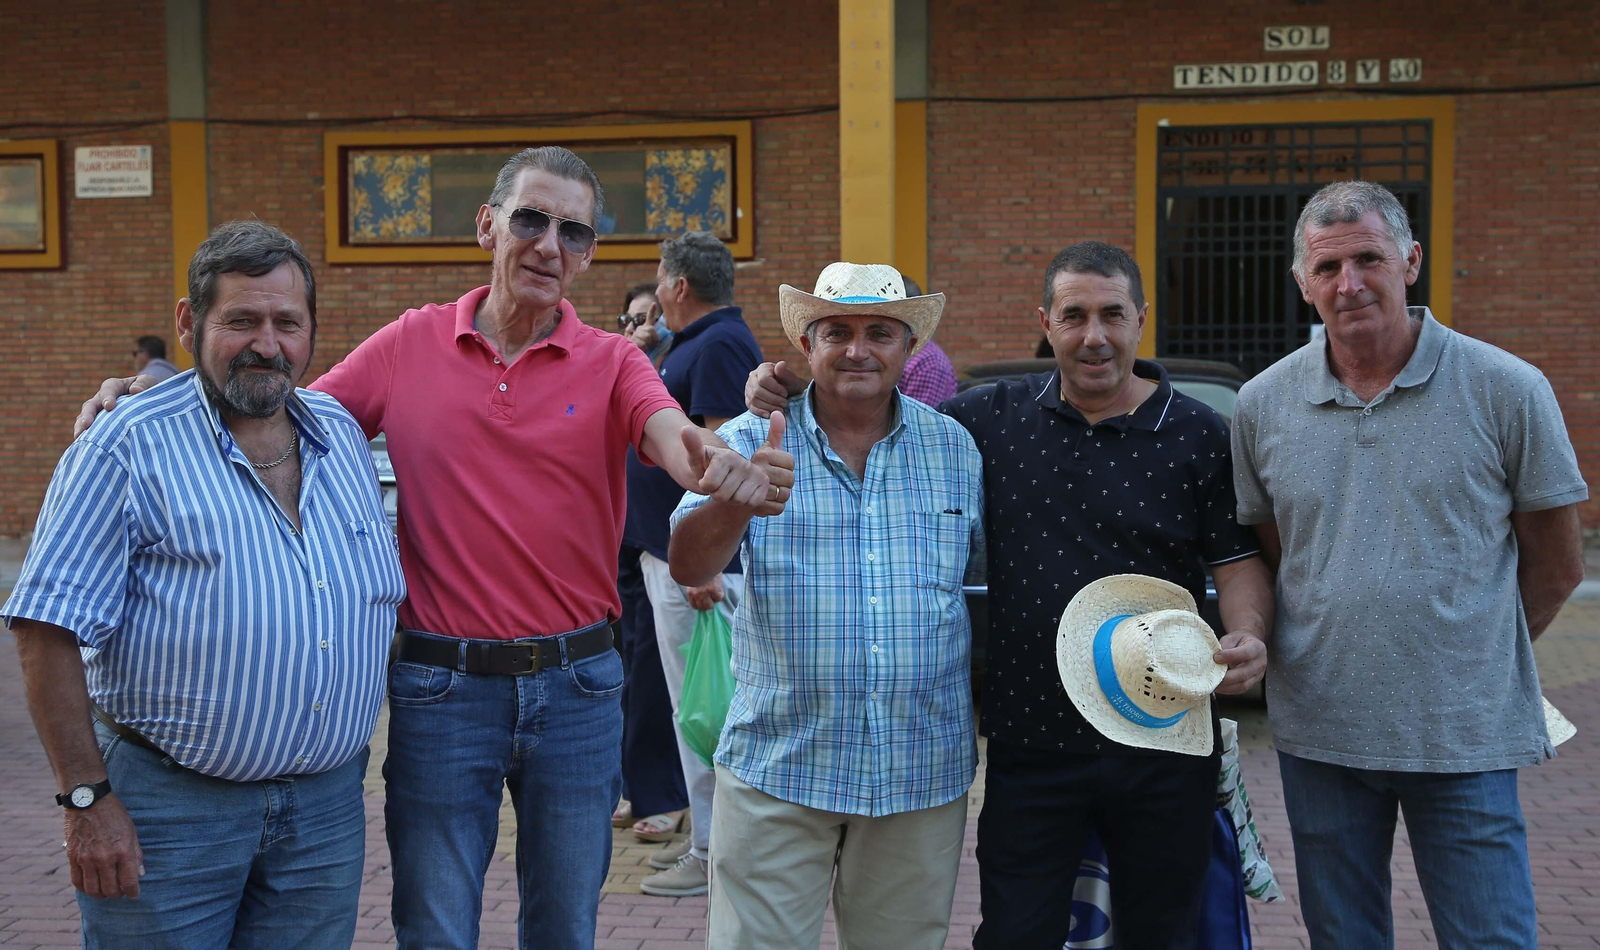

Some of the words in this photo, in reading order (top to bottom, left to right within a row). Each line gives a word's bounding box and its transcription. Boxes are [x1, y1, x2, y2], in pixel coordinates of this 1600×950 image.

[1267, 28, 1326, 48] SOL
[1177, 64, 1315, 85] TENDIDO
[1328, 62, 1344, 81] 8
[1359, 61, 1378, 81] Y
[88, 148, 137, 158] PROHIBIDO
[103, 160, 150, 172] CARTELES
[1122, 702, 1144, 720] TESORO
